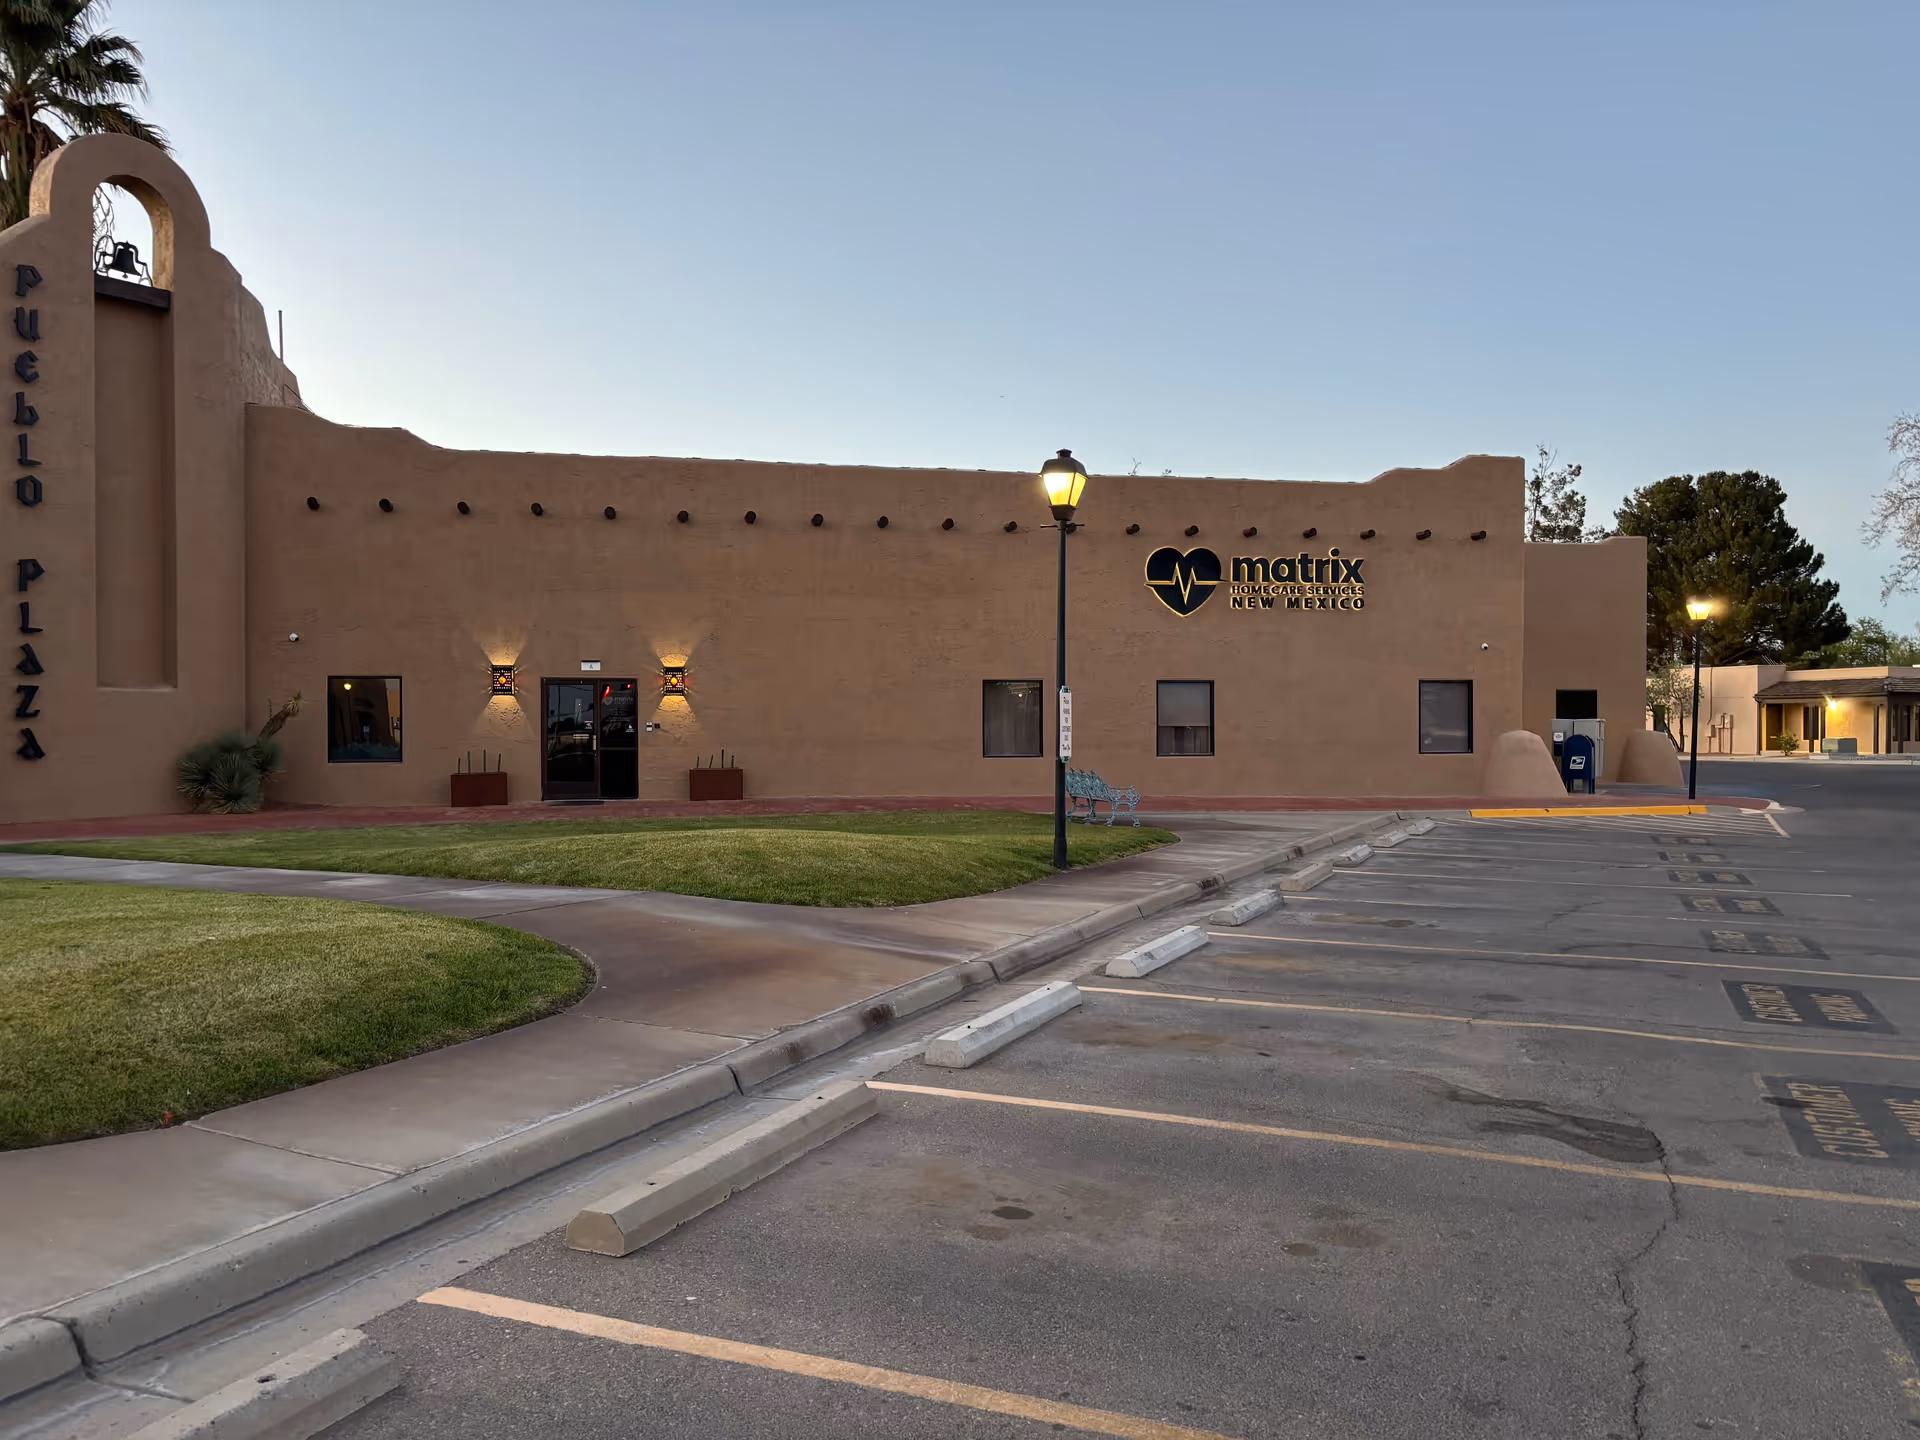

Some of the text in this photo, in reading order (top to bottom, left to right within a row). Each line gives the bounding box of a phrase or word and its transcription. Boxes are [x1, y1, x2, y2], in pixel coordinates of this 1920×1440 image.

[1230, 547, 1365, 585] matrix
[1230, 596, 1364, 610] NEW MEXICO
[1307, 585, 1364, 596] SERVICES
[1786, 1083, 1889, 1158] CUSTOMER
